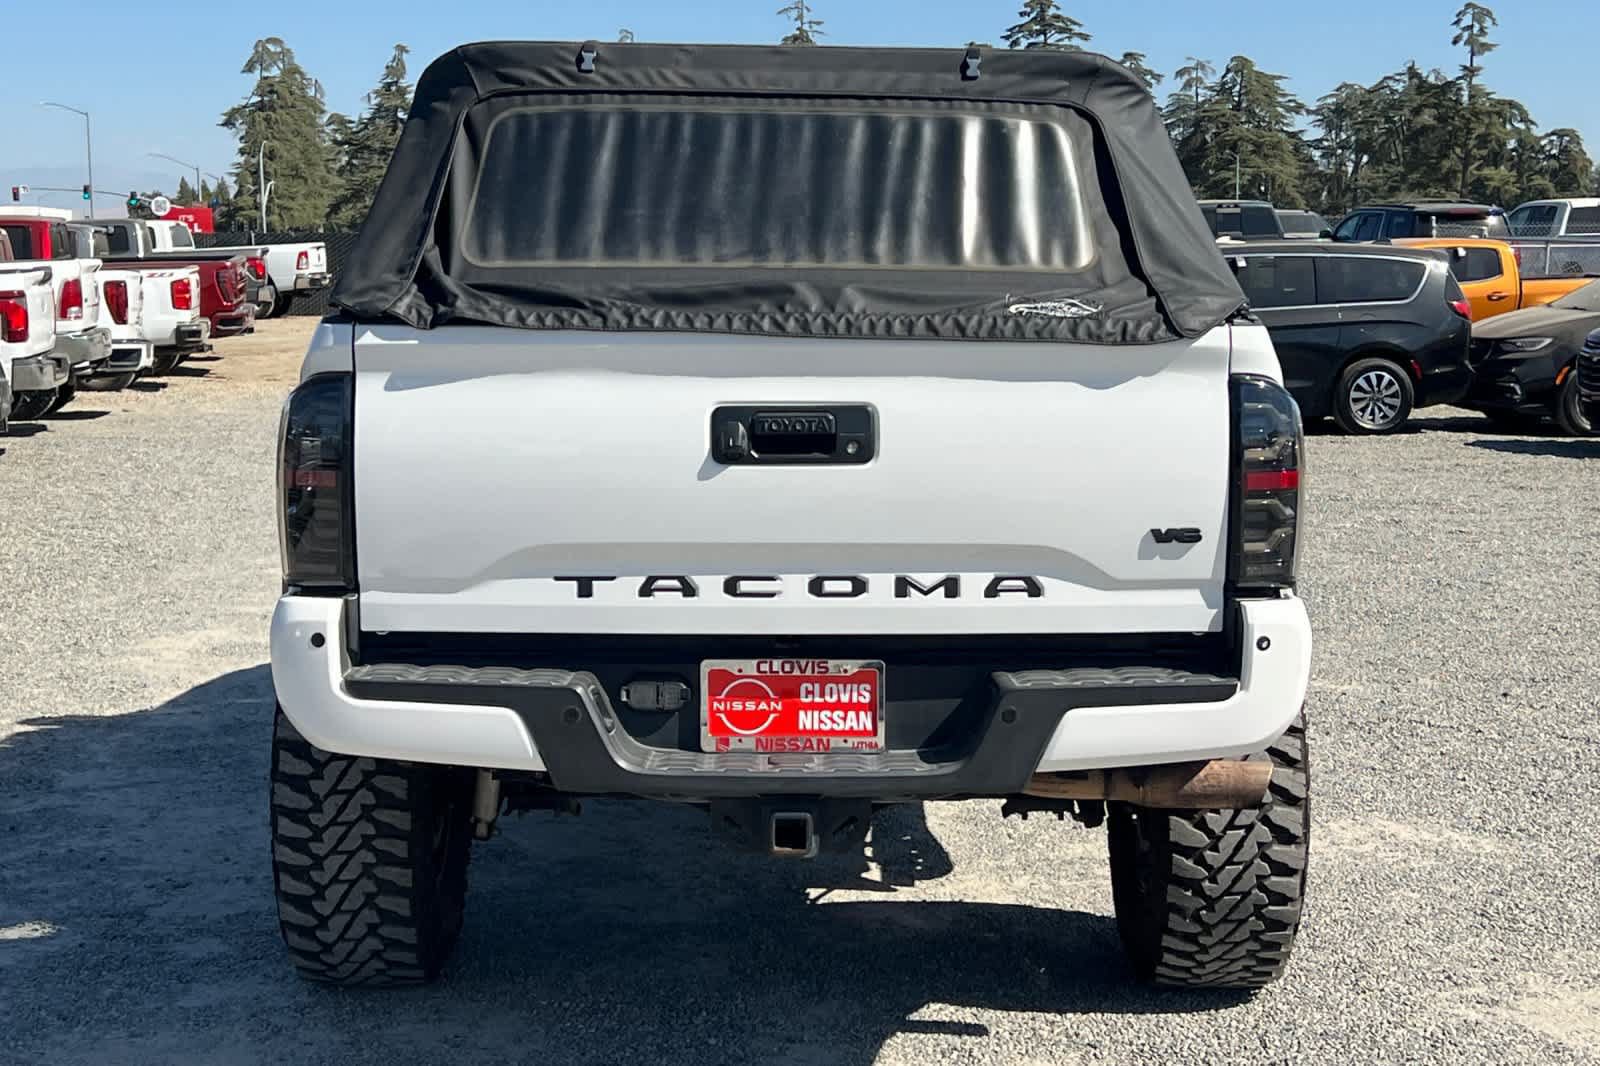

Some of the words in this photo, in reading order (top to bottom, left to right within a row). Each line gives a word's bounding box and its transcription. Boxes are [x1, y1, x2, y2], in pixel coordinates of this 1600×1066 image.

[759, 417, 830, 433] TOYOTA
[1150, 528, 1203, 543] V6
[553, 575, 1043, 598] TACOMA
[756, 660, 829, 674] CLOVIS
[800, 682, 872, 704] CLOVIS
[713, 701, 782, 711] NISSAN
[799, 710, 872, 731] NISSAN
[755, 738, 830, 752] NISSAN
